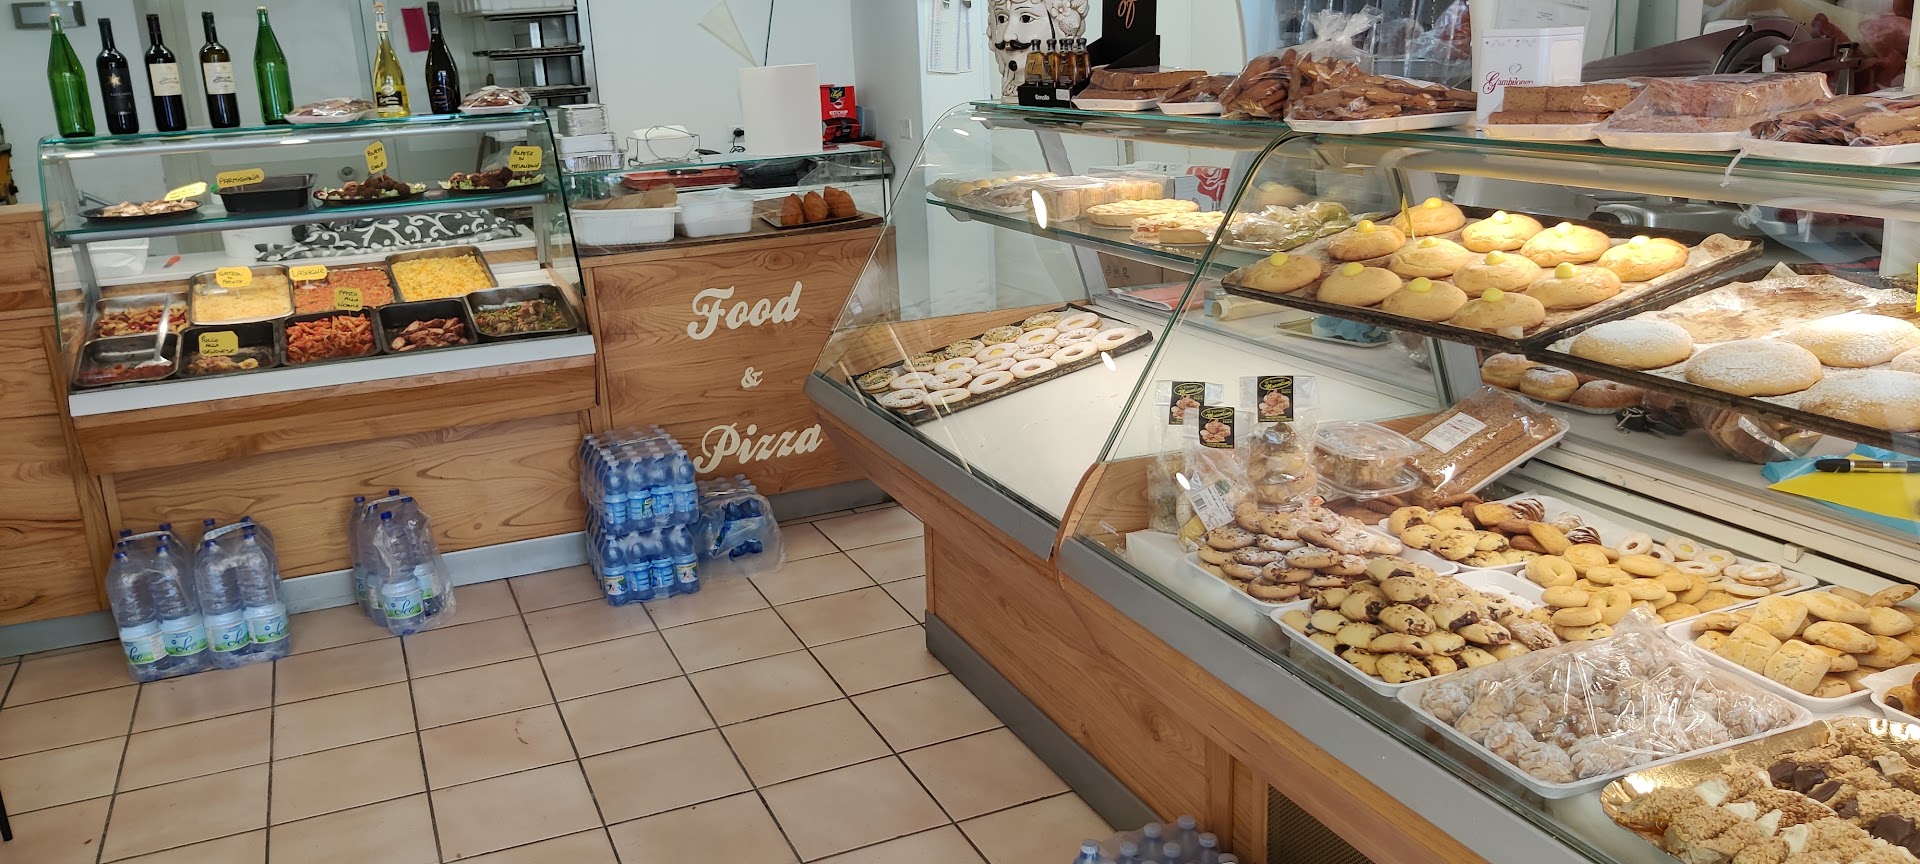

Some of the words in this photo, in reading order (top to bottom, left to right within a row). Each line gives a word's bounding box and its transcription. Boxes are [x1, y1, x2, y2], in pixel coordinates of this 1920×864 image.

[291, 268, 325, 278] LASAGNE
[338, 289, 358, 297] PASTA
[687, 280, 803, 340] Food
[741, 366, 763, 388] &
[693, 422, 823, 474] Pizza
